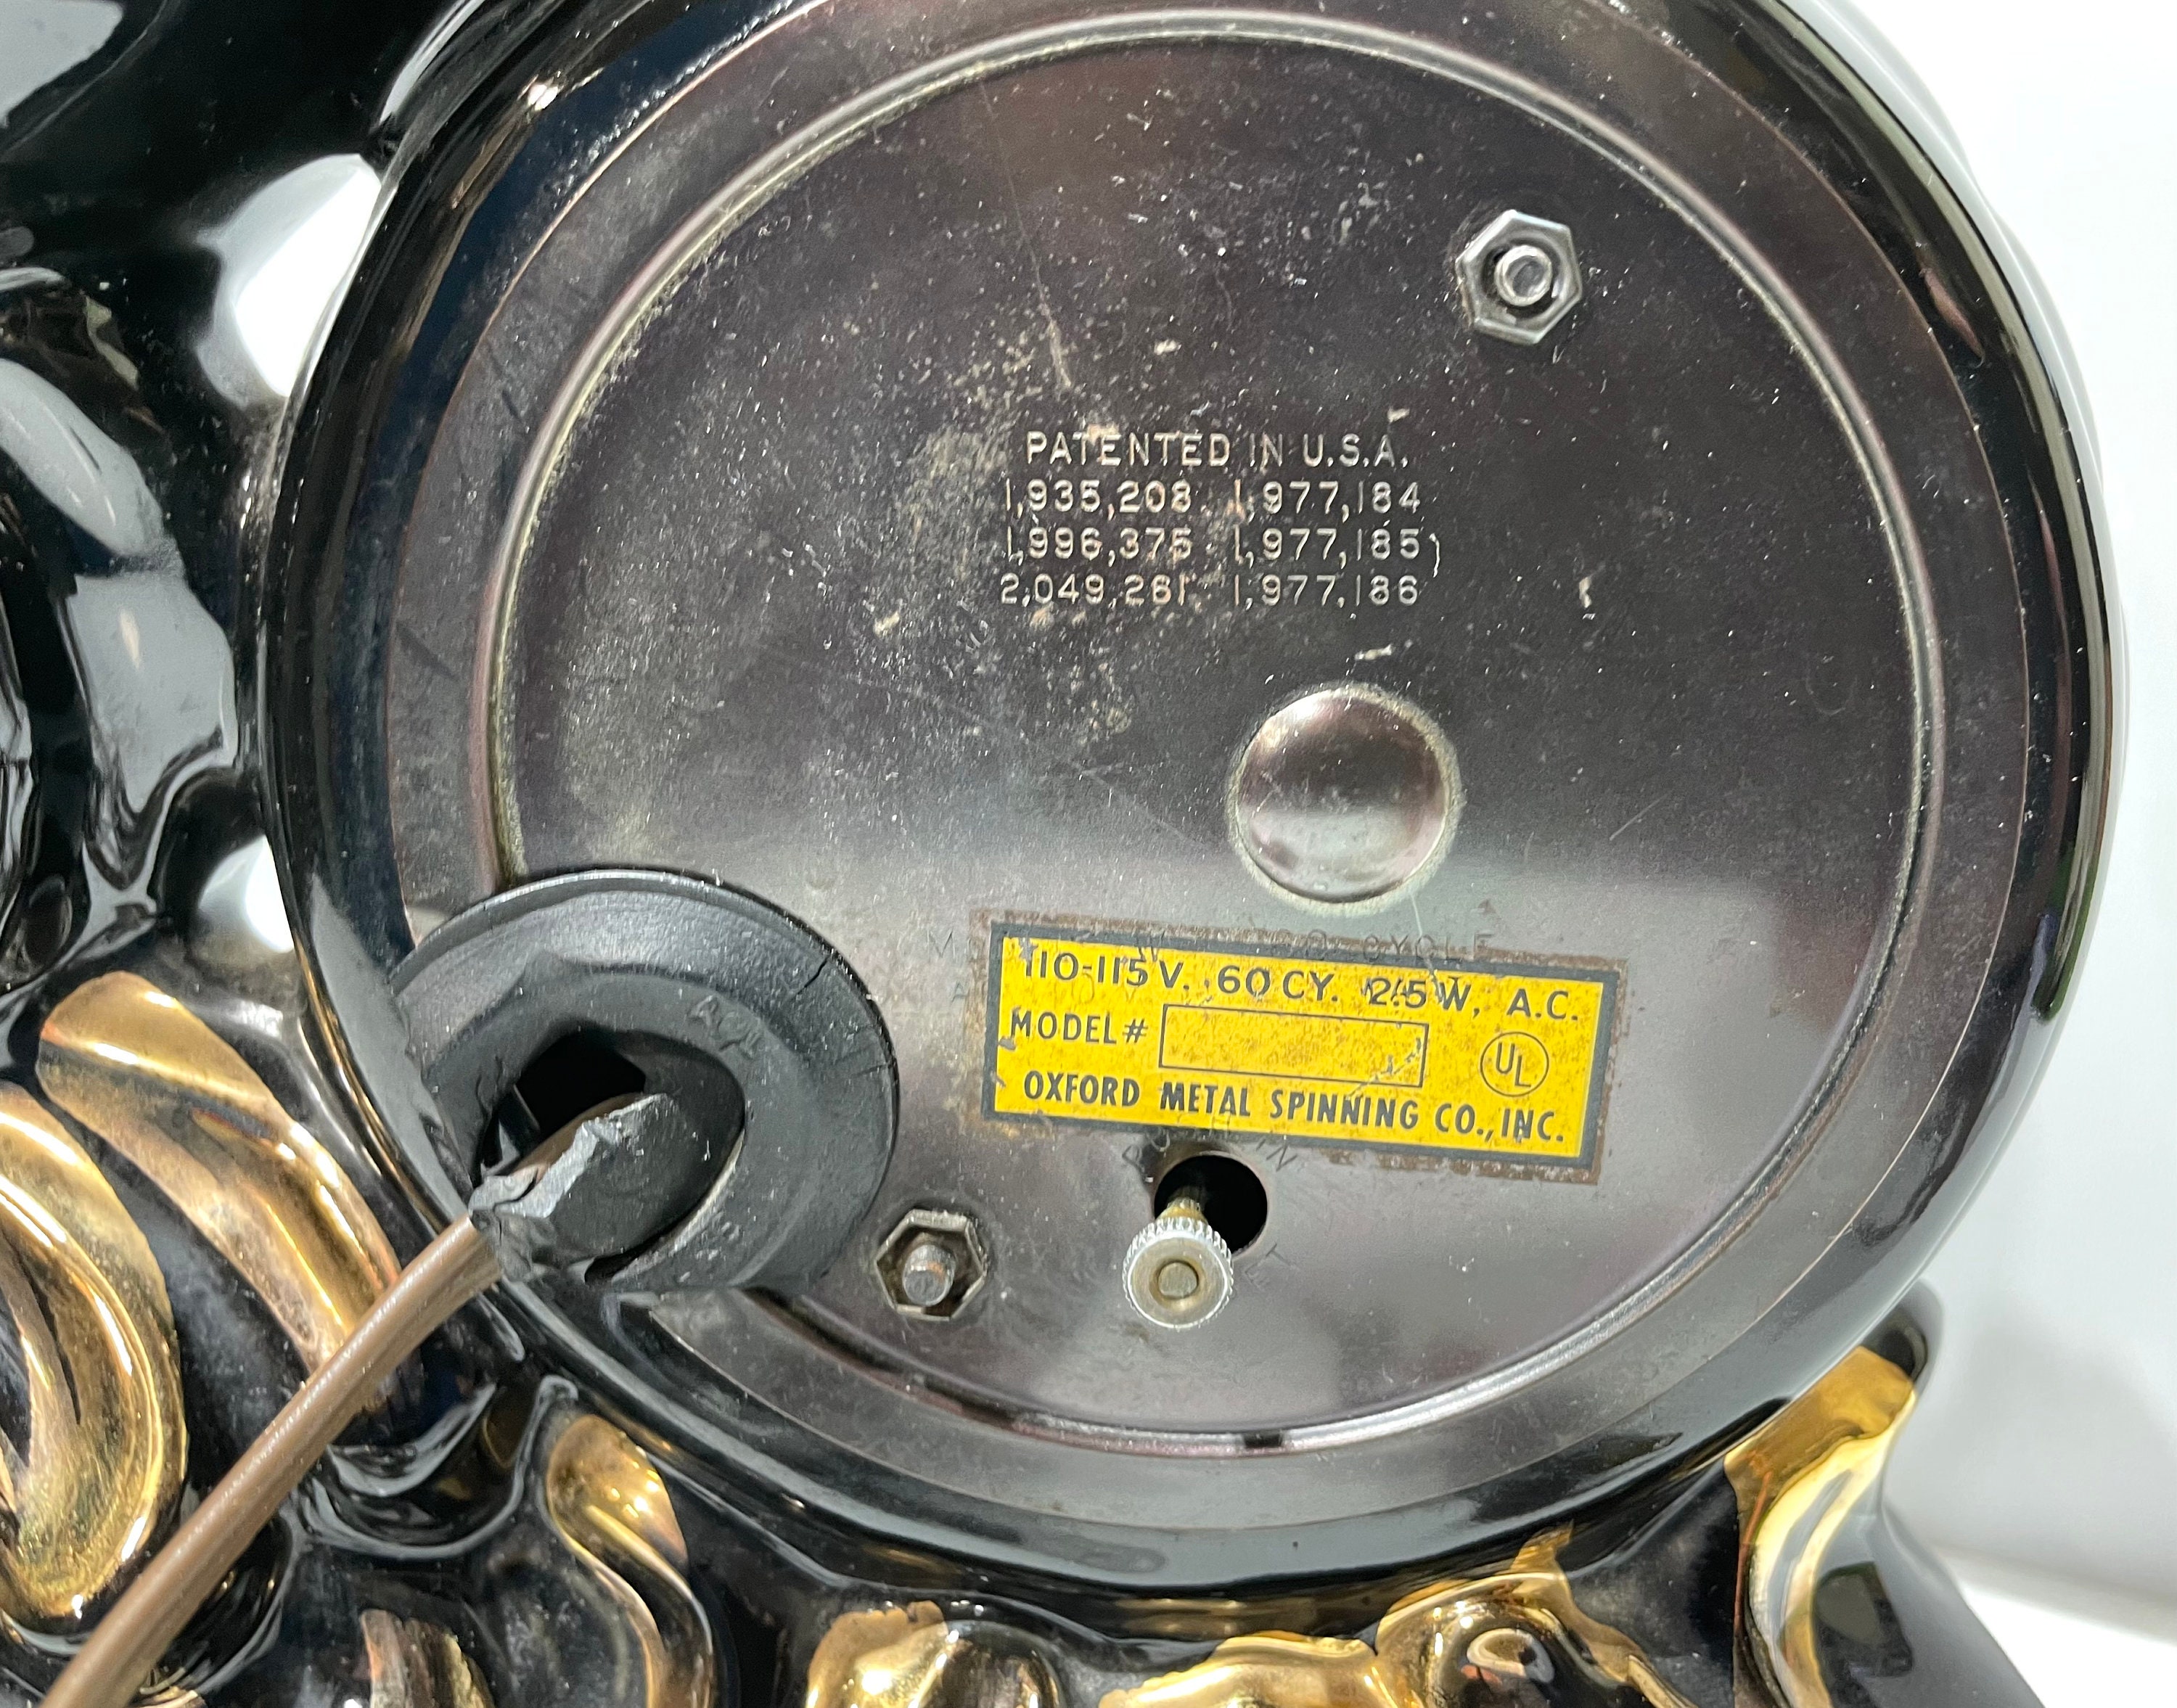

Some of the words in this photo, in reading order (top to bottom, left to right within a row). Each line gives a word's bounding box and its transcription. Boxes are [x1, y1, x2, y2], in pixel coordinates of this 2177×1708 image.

[1027, 430, 1230, 467] PATENTED
[1248, 432, 1283, 468] IN
[1303, 433, 1409, 468] U.S.A.
[1005, 477, 1192, 522] 1,935,208
[1234, 478, 1421, 523] 1,977,184
[1006, 525, 1194, 567] 1,996,375
[1234, 524, 1420, 569] 1,977,185
[1506, 988, 1580, 1022] A.C.
[1023, 1069, 1141, 1107] OXFORD
[1160, 1081, 1251, 1117] METAL
[1269, 1088, 1419, 1130] SPINNING
